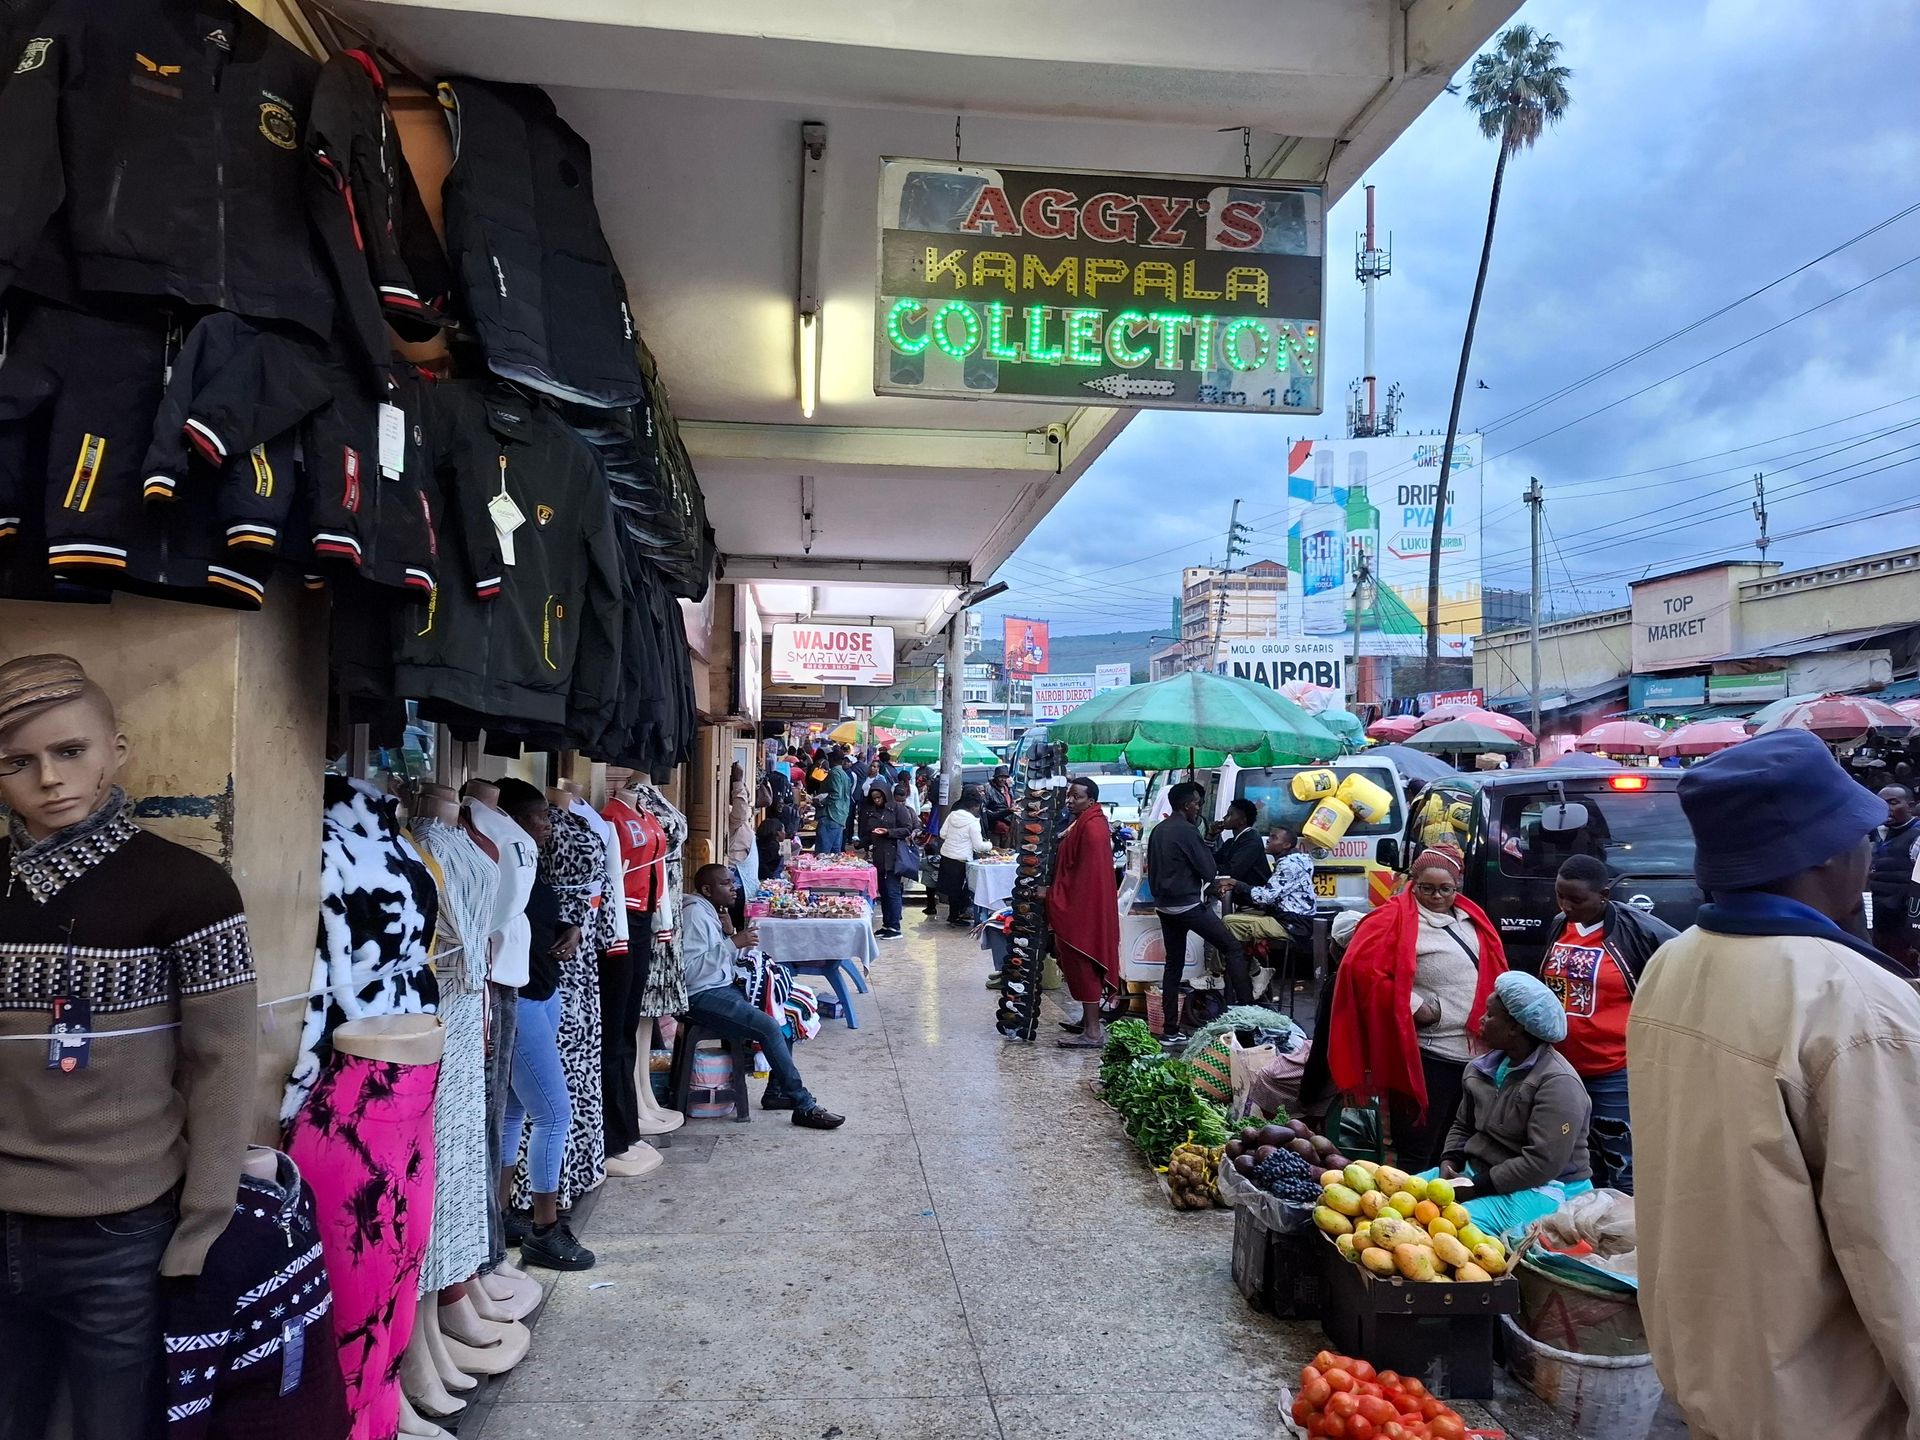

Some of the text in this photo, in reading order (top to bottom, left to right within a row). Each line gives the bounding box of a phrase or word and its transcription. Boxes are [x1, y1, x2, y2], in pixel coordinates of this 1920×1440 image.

[960, 185, 1265, 250] AGGY'S
[925, 246, 1270, 308] KAMPALA
[887, 299, 1318, 374] COLLECTION
[1401, 538, 1428, 550] LUKU
[1664, 595, 1693, 615] TOP
[1648, 617, 1706, 643] MARKET
[793, 630, 873, 652] WAJOSE
[1231, 645, 1255, 654] MOLO
[1262, 645, 1290, 654] GROUP
[1294, 644, 1334, 654] SAFARIS
[787, 651, 876, 666] SMARTWEAR
[1233, 660, 1341, 690] NAIROBI
[1035, 689, 1092, 702] NAIROBI DIRECT
[1435, 691, 1478, 708] Eversafe
[1042, 705, 1060, 716] TEA
[625, 820, 647, 849] B
[1332, 841, 1368, 857] GROUP
[1500, 918, 1542, 927] NV200
